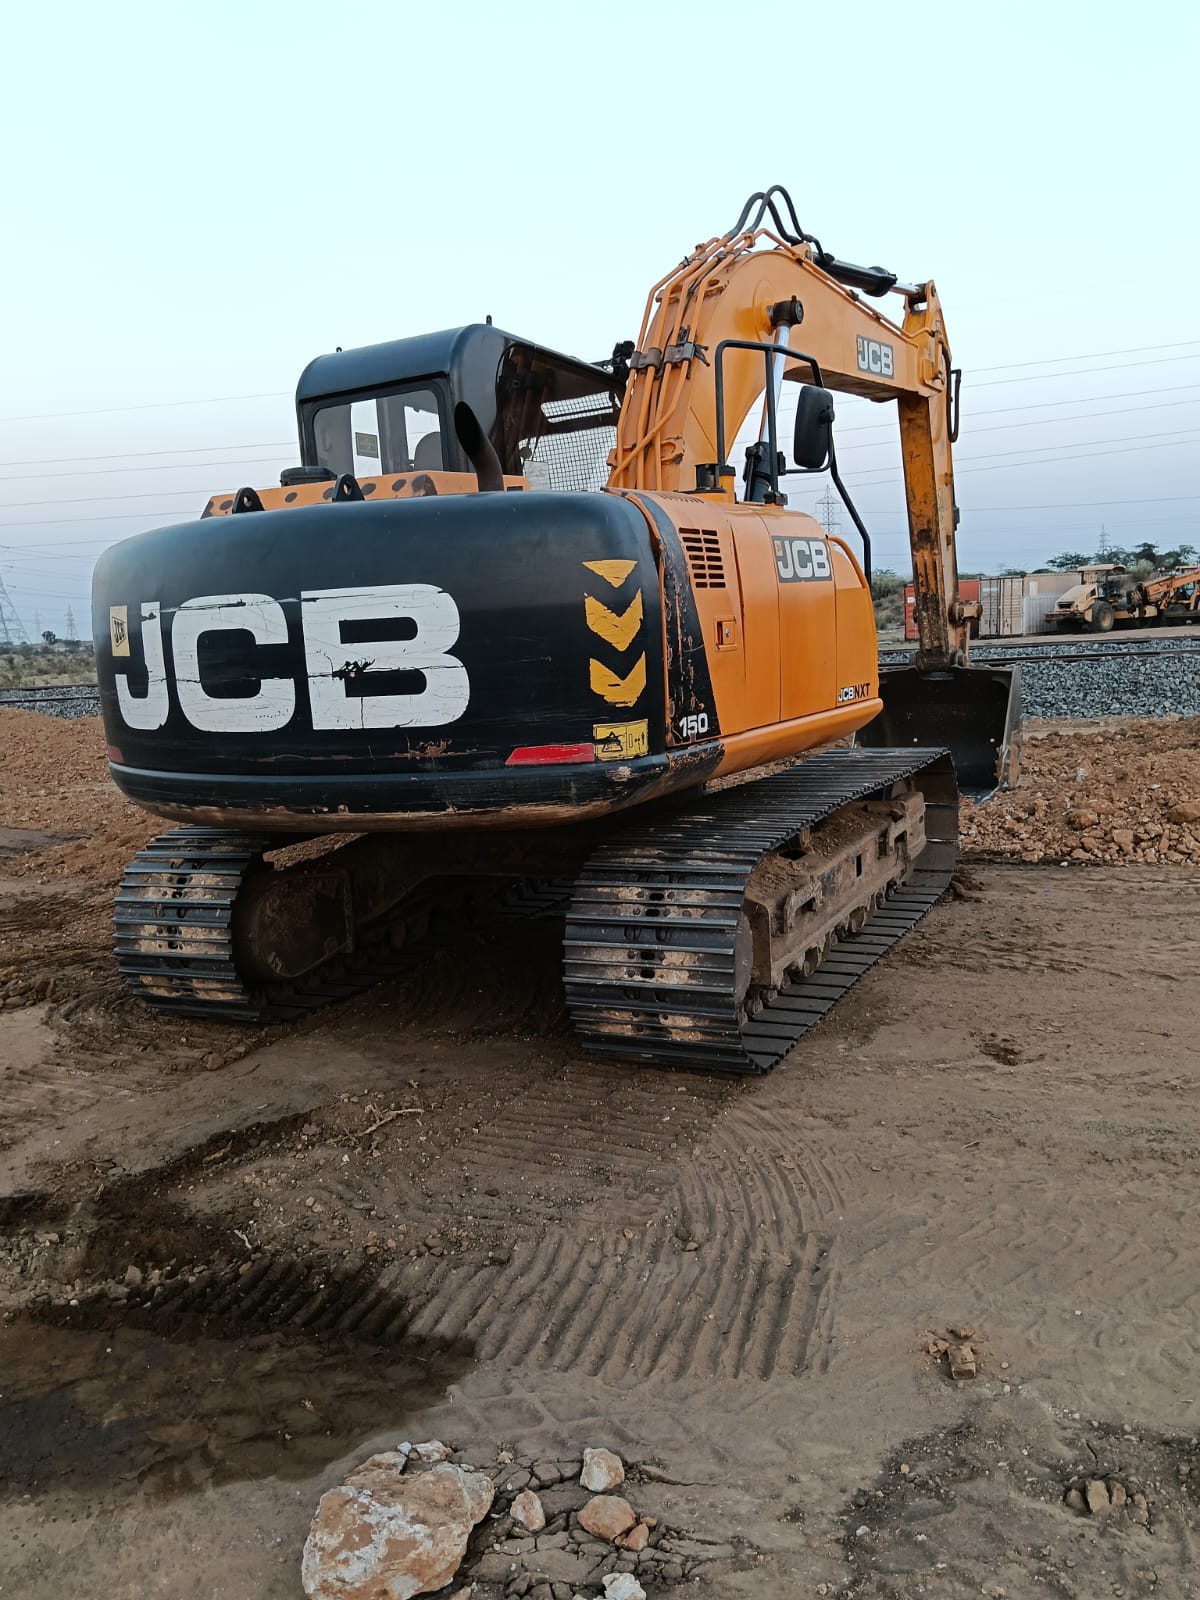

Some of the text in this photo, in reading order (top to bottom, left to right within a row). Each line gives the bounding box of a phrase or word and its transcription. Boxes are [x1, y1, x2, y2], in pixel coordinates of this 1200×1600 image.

[858, 340, 893, 376] JCB
[777, 540, 830, 578] JCB
[115, 583, 470, 733] JCB
[679, 712, 708, 737] 150
